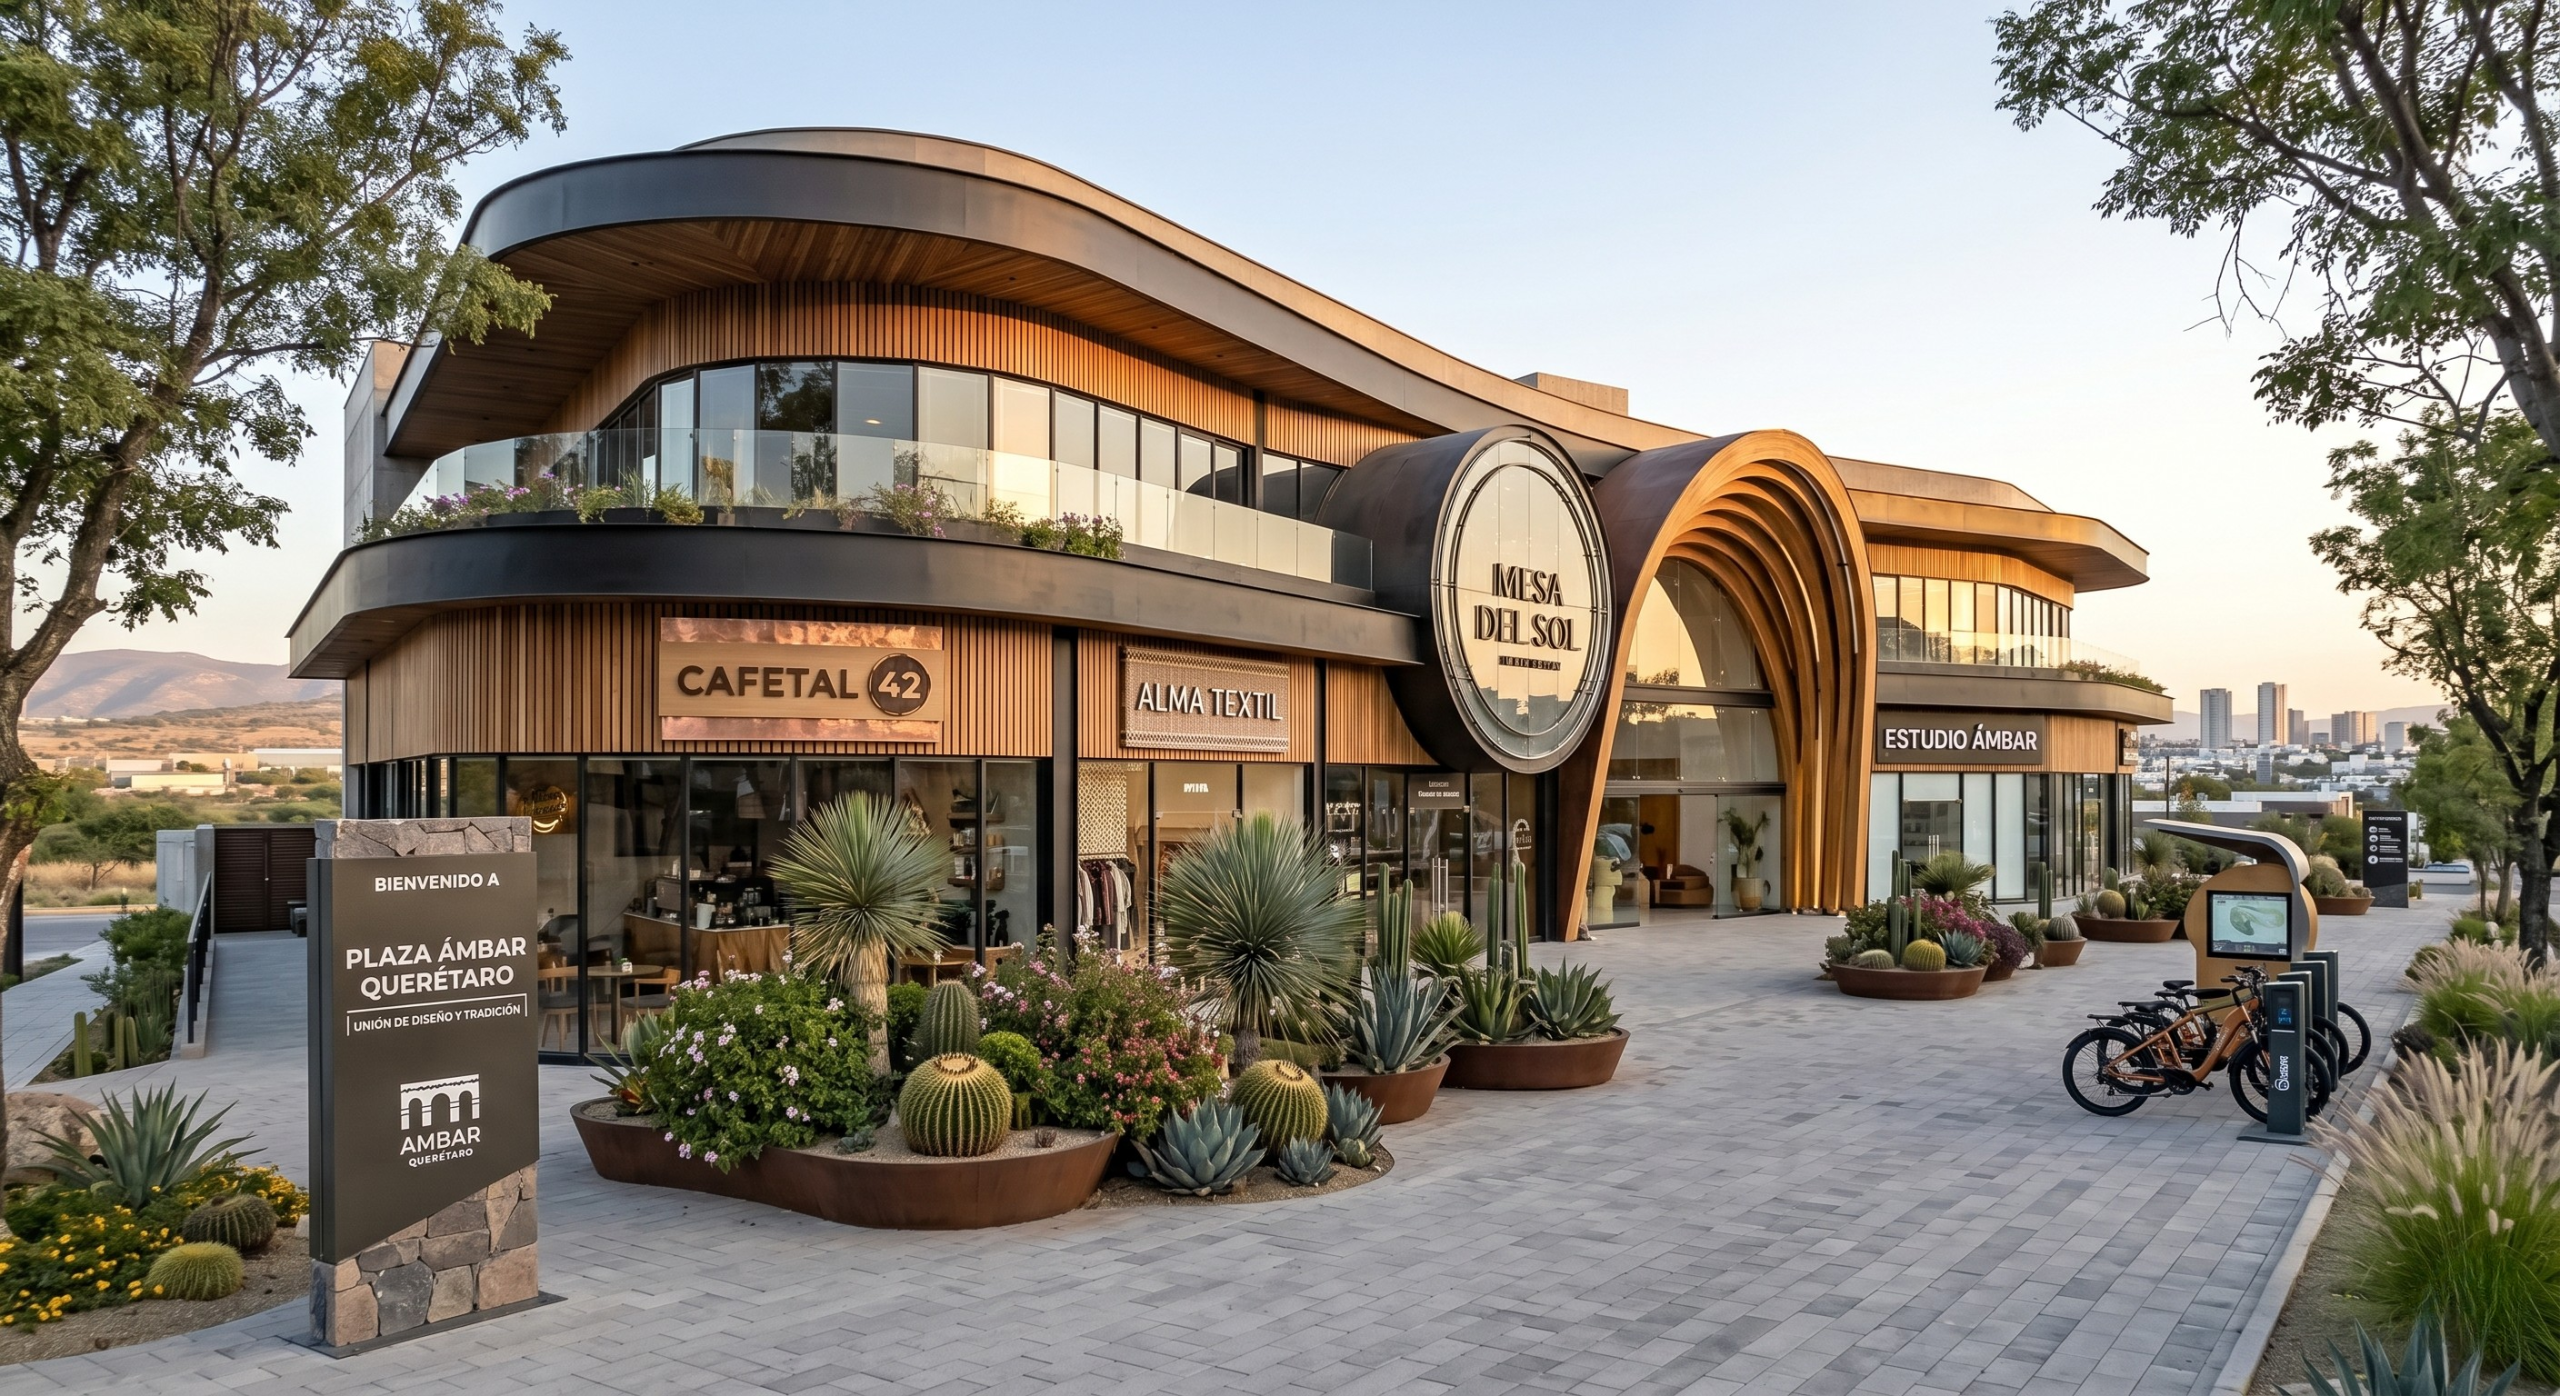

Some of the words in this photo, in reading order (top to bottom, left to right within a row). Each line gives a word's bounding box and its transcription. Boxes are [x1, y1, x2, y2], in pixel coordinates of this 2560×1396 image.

[1492, 563, 1563, 606] MESA
[1474, 605, 1529, 645] DEL
[1531, 614, 1582, 651] SOL
[677, 665, 858, 699] CAFETAL
[878, 671, 921, 699] 42
[1138, 682, 1204, 714] ALMA
[1210, 688, 1283, 720] TEXTIL
[1885, 729, 1968, 750] ESTUDIO
[1971, 723, 2038, 751] ÁMBAR
[375, 873, 483, 892] BIENVENIDO
[486, 872, 500, 887] A
[346, 944, 432, 970] PLAZA
[438, 937, 526, 962] ÁMBAR
[360, 965, 514, 1000] QUERÉTARO
[353, 1018, 392, 1032] UNIÓN
[394, 1016, 409, 1028] DE
[411, 1010, 453, 1026] DISEÑO
[454, 1011, 463, 1021] Y
[463, 1003, 521, 1020] TRADICIÓN
[399, 1126, 481, 1155] AMBAR
[408, 1148, 474, 1168] QUERÉTARO
